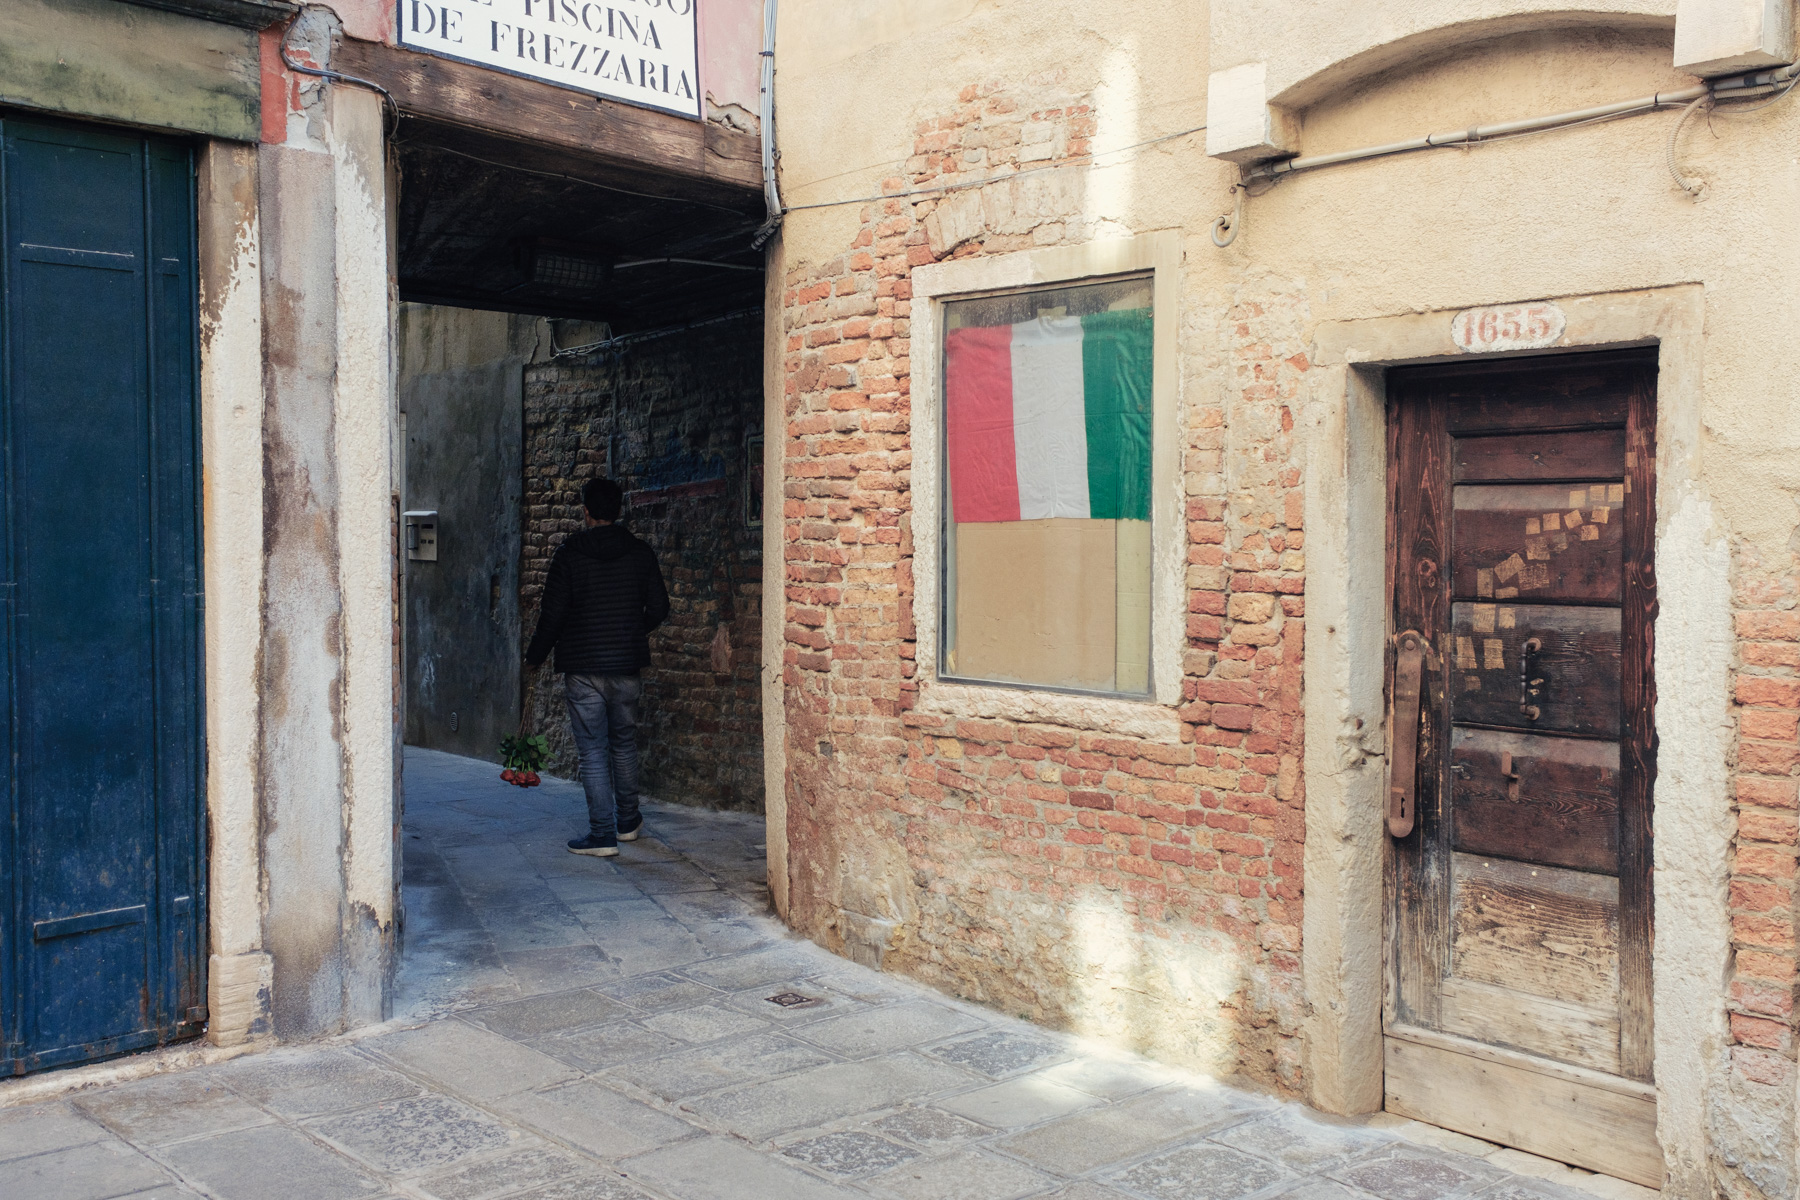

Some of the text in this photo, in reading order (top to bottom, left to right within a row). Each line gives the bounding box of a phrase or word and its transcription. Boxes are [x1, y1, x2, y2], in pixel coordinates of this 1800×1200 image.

[411, 0, 694, 100] DE FREZZARIA
[1464, 306, 1550, 346] 1655
